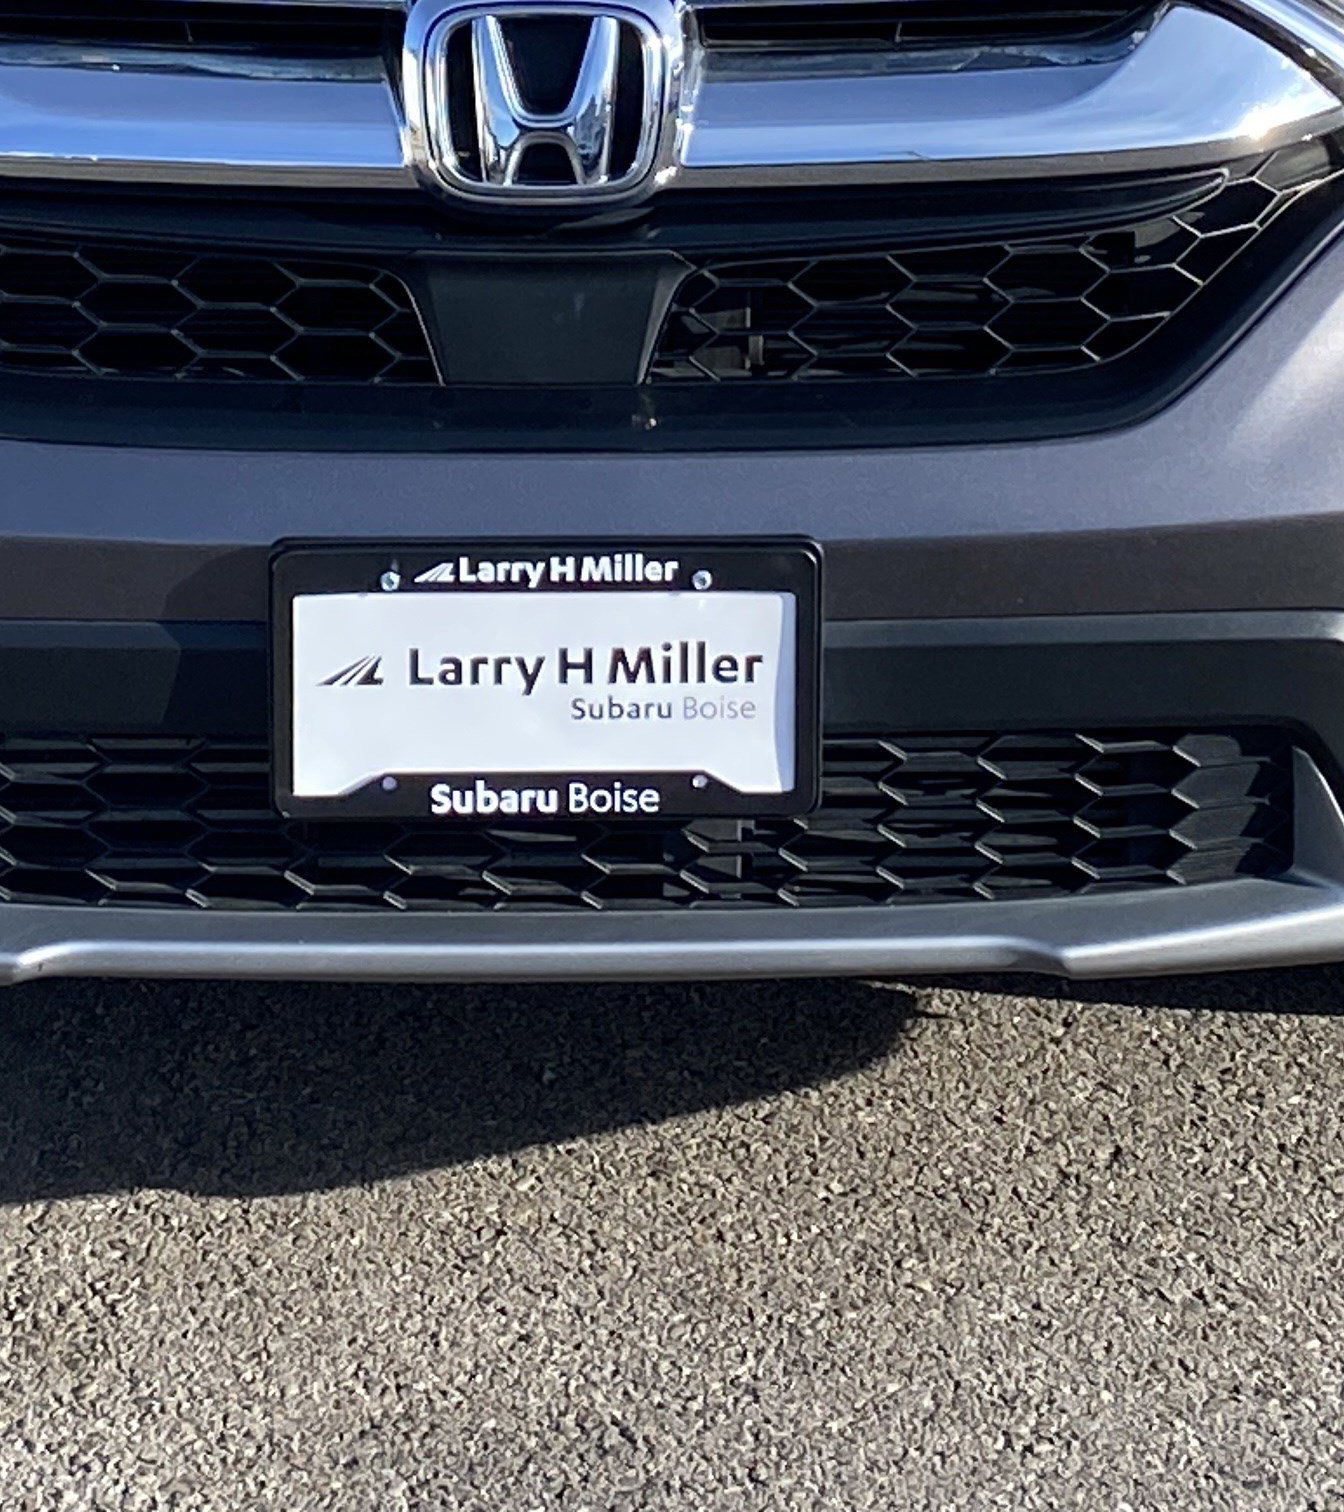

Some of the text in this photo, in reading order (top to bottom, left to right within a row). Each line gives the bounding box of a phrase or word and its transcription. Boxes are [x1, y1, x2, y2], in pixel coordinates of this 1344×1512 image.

[459, 553, 679, 588] Larry H Miller
[408, 641, 764, 696] Larry H Miller
[570, 694, 757, 721] Subaru Boise
[430, 779, 661, 815] Subaru Boise
